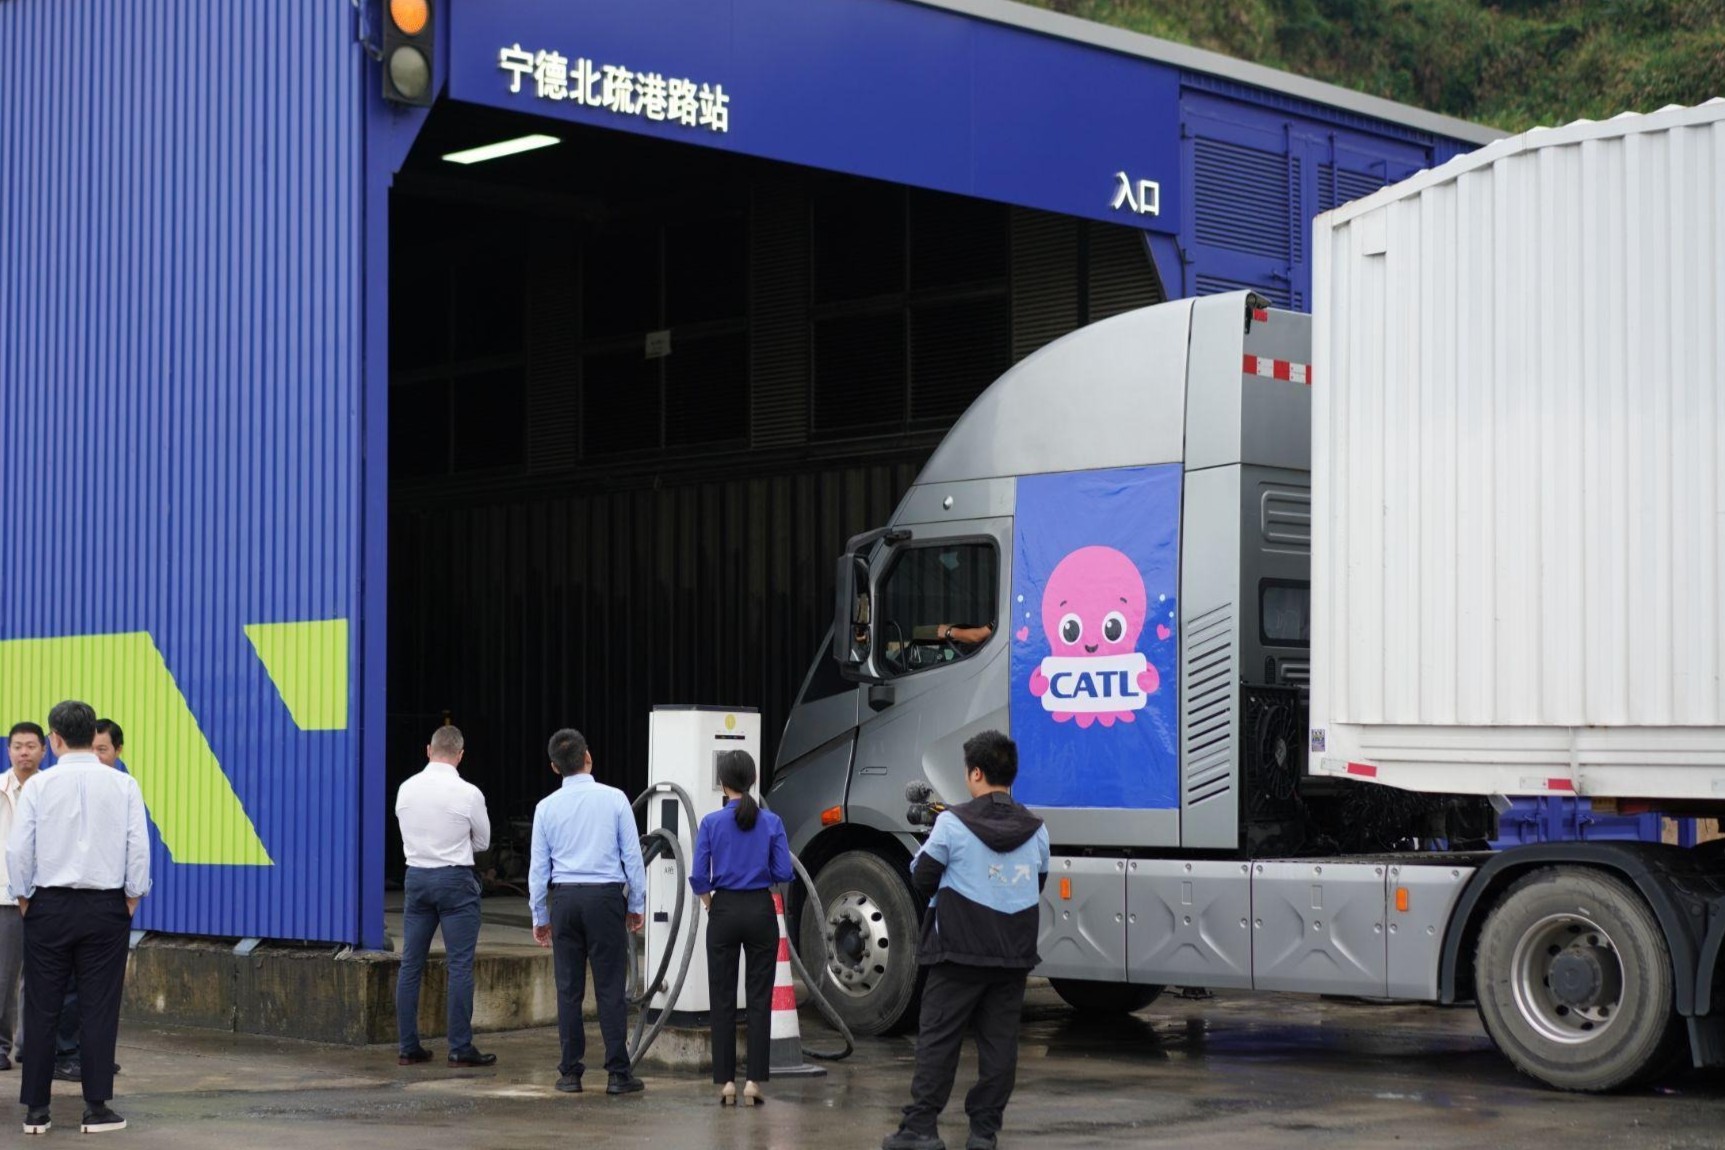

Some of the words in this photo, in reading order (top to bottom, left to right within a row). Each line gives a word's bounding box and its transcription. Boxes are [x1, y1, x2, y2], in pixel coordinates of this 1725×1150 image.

[499, 43, 730, 132] 宁德北疏港路站
[1111, 171, 1160, 216] 入口
[1050, 671, 1139, 698] CATL
